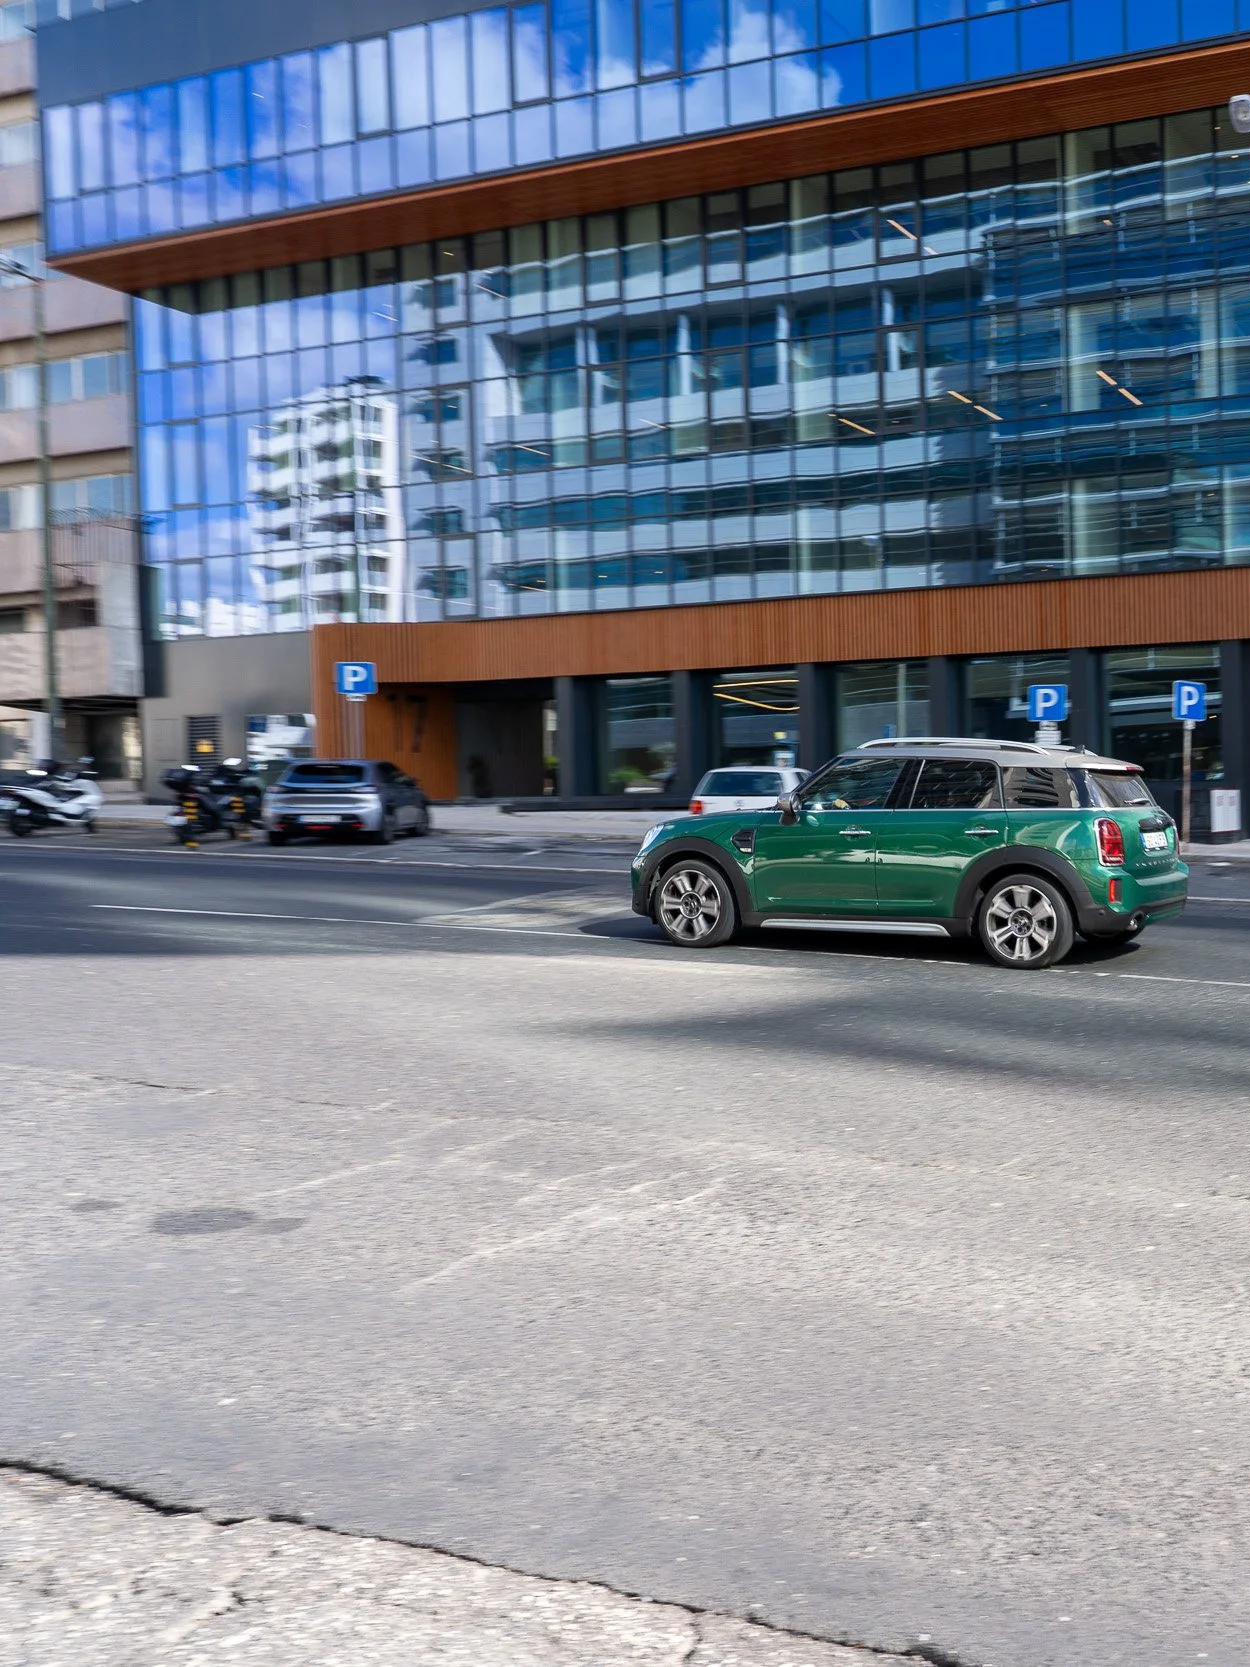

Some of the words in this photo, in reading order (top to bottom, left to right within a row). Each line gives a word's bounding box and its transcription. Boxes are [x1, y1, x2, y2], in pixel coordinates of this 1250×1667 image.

[343, 665, 367, 691] P
[1036, 688, 1059, 717] P
[1180, 686, 1199, 715] P
[386, 692, 428, 754] 17
